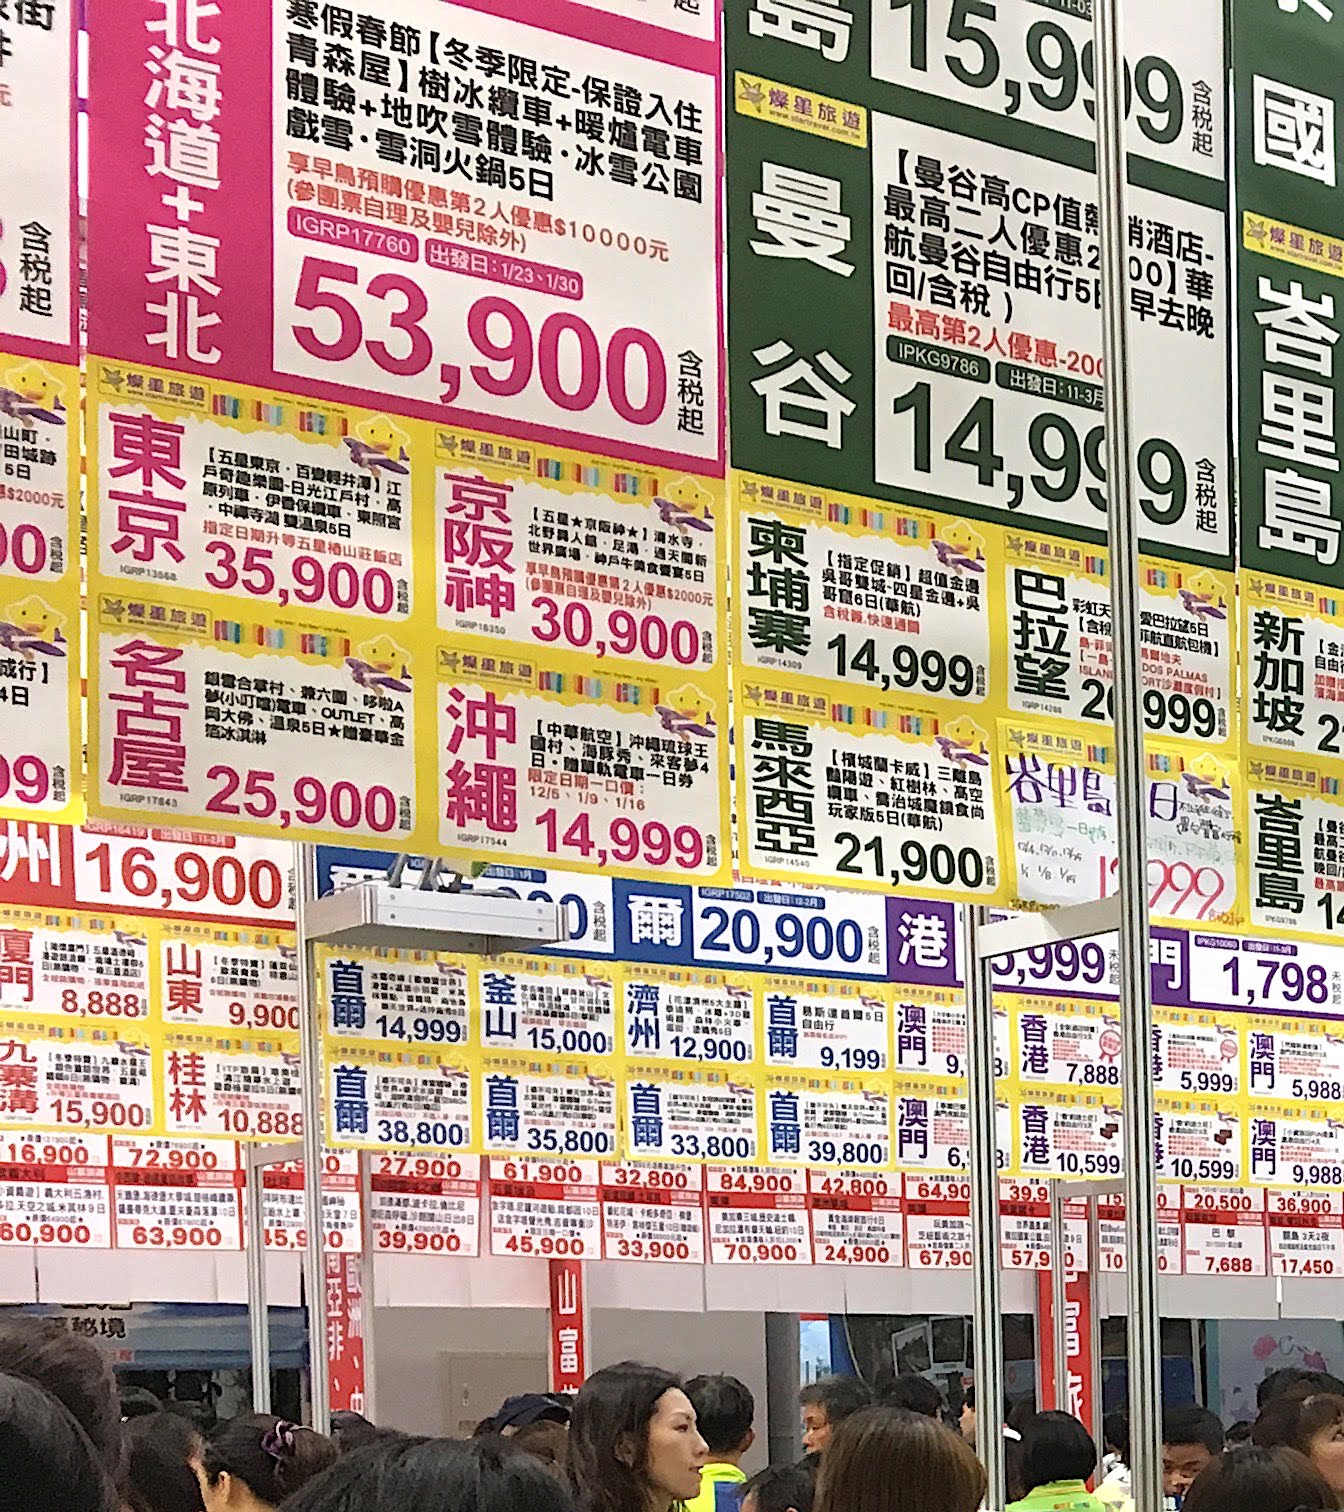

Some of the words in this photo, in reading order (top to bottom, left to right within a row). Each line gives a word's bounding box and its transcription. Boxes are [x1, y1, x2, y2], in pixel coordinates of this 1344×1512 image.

[295, 214, 410, 256] IGRP17760
[750, 161, 856, 451] 曼谷
[291, 256, 666, 426] 53,900
[897, 342, 980, 379] IPKG9786
[1255, 275, 1344, 568] 峇里島
[108, 412, 187, 564] 東京
[204, 540, 394, 617] 35,900
[443, 473, 516, 620] 京阪神
[746, 517, 812, 657] 柬埔寨
[531, 596, 699, 665] 30,900
[1012, 567, 1071, 701] 巴拉望
[826, 632, 973, 697] 14,999
[1252, 610, 1305, 737] 新加坡
[107, 639, 190, 794] 名古屋
[445, 687, 517, 833] 沖繩
[752, 718, 818, 858] 馬來西亞
[205, 764, 396, 832] 25,900
[535, 808, 702, 869] 14,999
[834, 832, 984, 889] 21,900
[1254, 795, 1305, 914] 峇里島
[85, 842, 282, 909] 16,900
[699, 905, 864, 965] 20,900
[61, 988, 141, 1019] 8,888
[330, 959, 368, 1031] 首爾
[483, 972, 517, 1040] 釜山
[1222, 954, 1329, 1004] 1,798
[375, 1015, 462, 1044] 14,999
[526, 1026, 607, 1055] 15,000
[627, 983, 661, 1051] 濟州
[669, 1035, 748, 1062] 12,900
[168, 1050, 207, 1125] 桂林
[819, 1046, 882, 1071] 9,199
[49, 1099, 145, 1129] 15,900
[377, 1119, 464, 1147] 38,800
[128, 1148, 218, 1169] 72,900
[133, 1225, 223, 1247] 63,900
[378, 1232, 461, 1252] 39,900
[505, 1235, 584, 1255] 45,900
[825, 1244, 890, 1263] 24,900
[1204, 1255, 1253, 1273] 7,688
